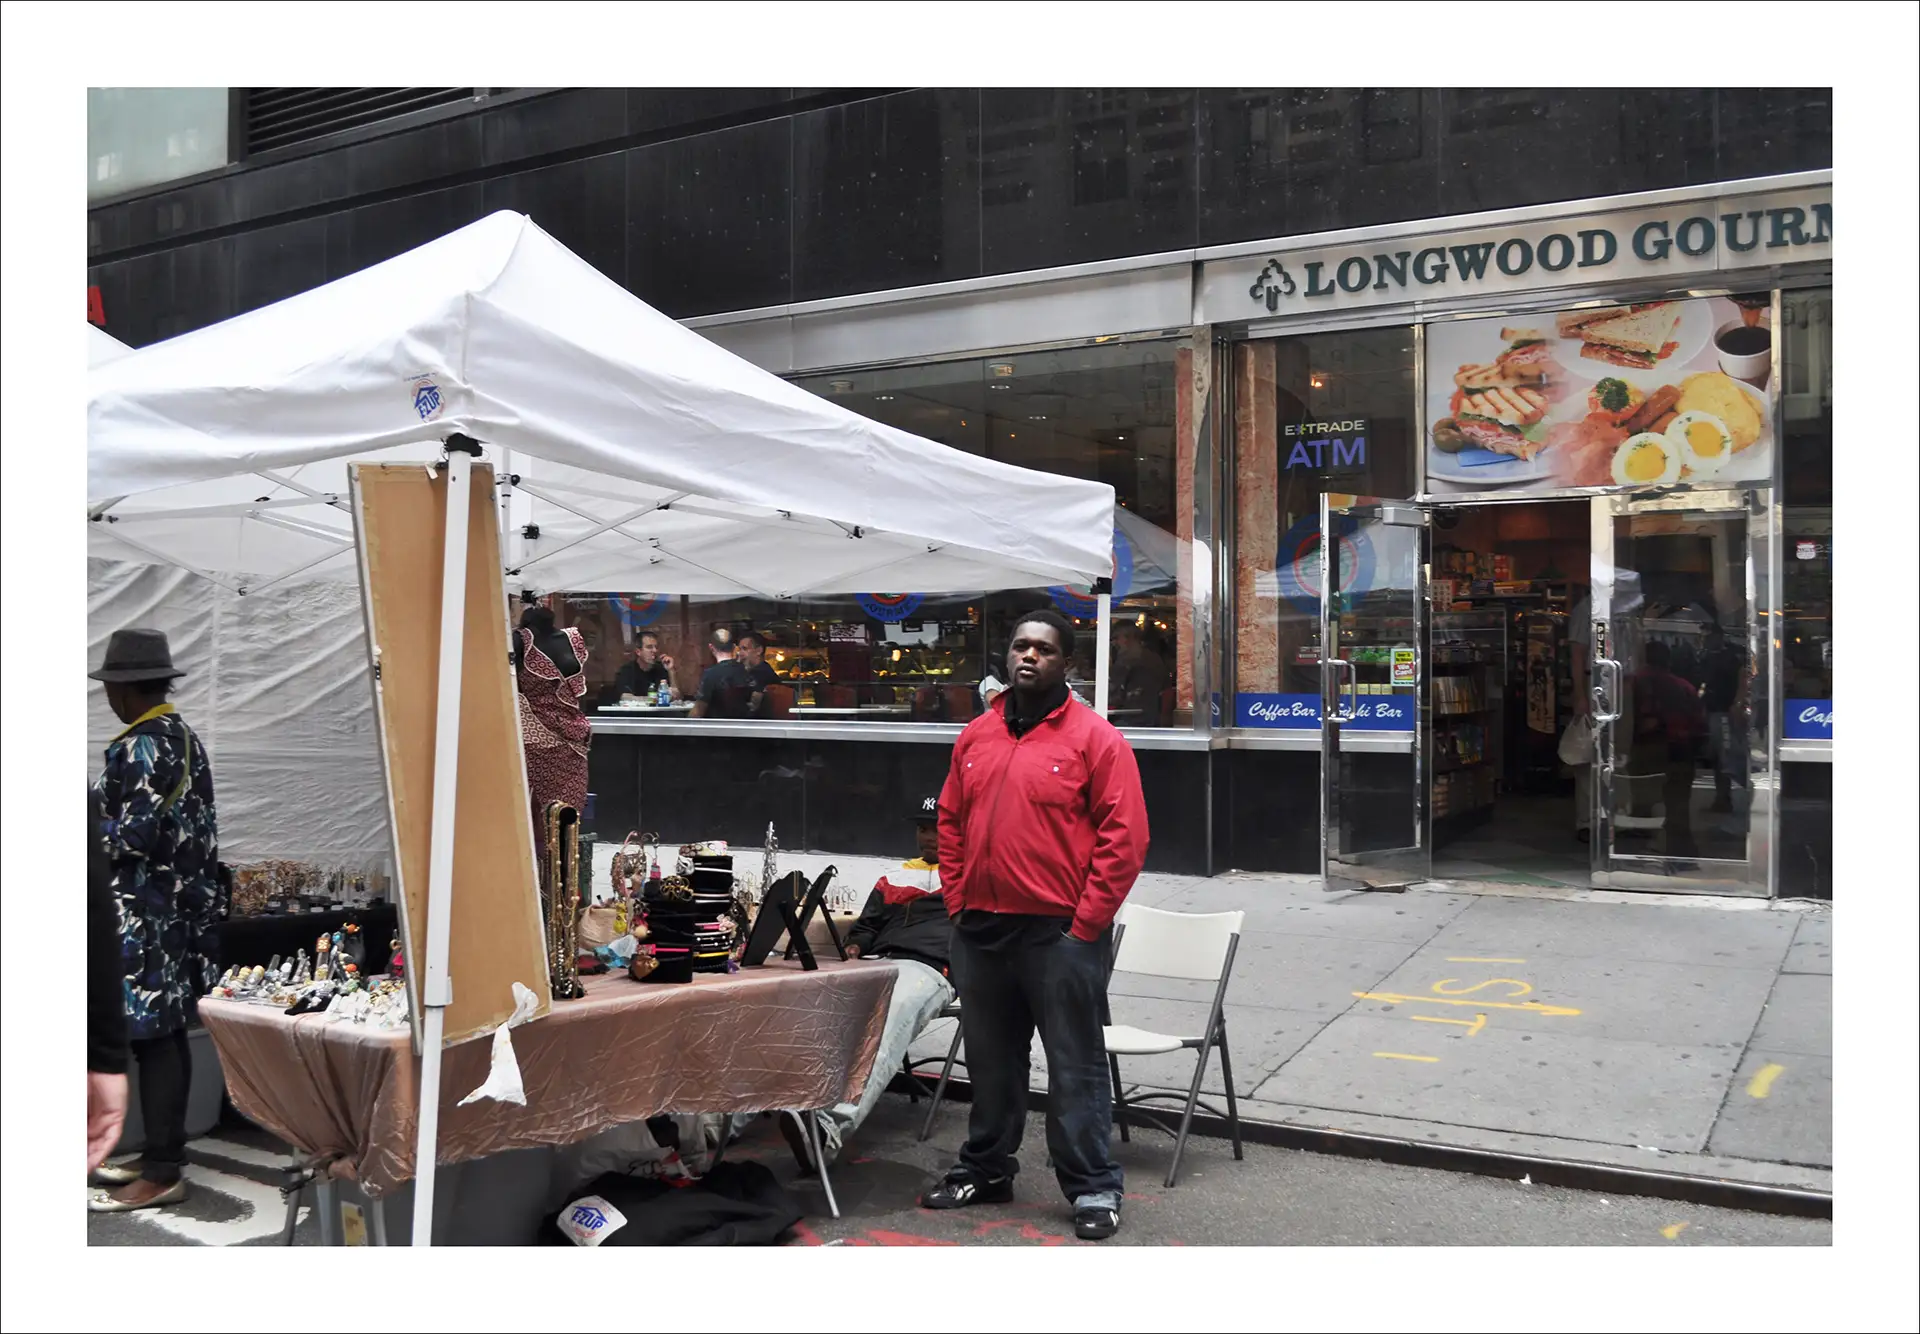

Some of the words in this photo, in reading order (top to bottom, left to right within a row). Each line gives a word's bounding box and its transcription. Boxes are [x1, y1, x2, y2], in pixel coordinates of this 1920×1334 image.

[1304, 229, 1617, 297] LONGWOOD
[1284, 437, 1365, 470] ATM
[1249, 701, 1290, 721] Coffee
[1291, 702, 1316, 717] Bar
[1376, 703, 1404, 718] Bar
[922, 797, 936, 810] NY
